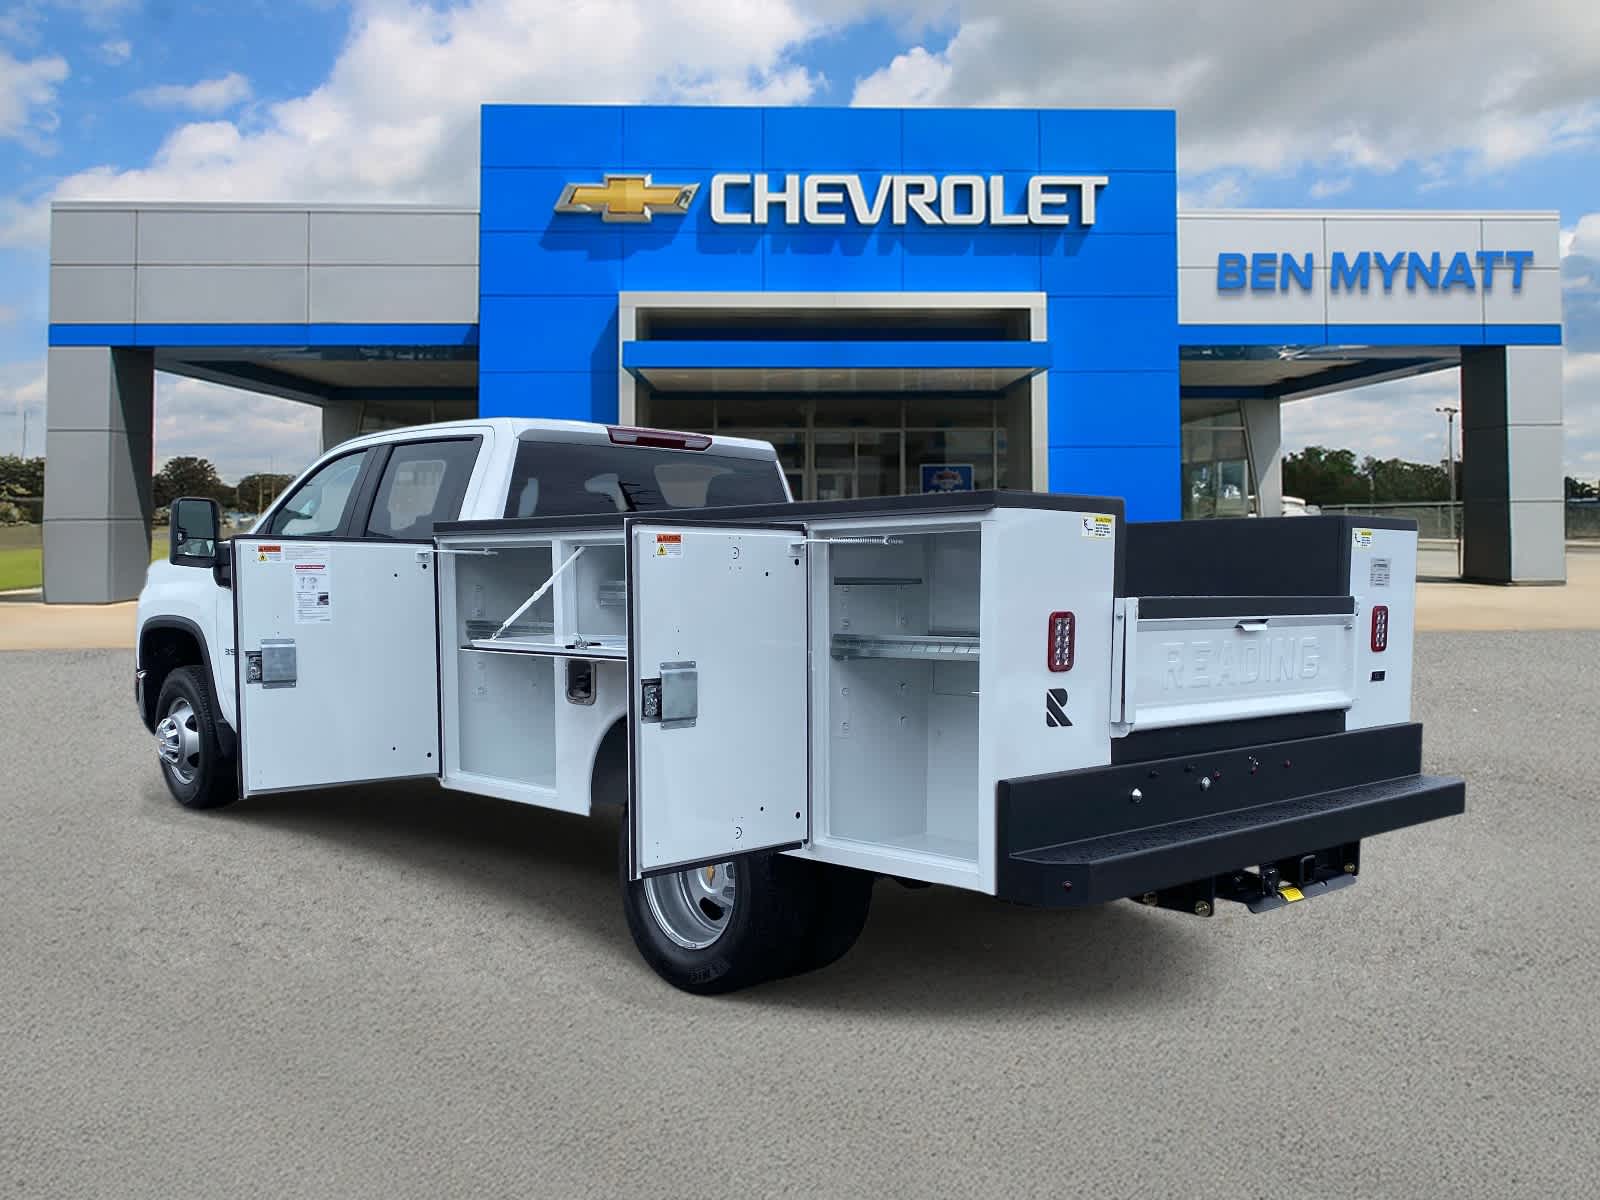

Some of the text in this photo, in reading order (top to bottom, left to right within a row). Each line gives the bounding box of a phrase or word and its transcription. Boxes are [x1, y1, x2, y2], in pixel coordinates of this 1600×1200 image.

[711, 174, 1109, 225] CHEVROLET
[1216, 250, 1534, 291] BEN MYNATT
[1160, 636, 1321, 690] READING
